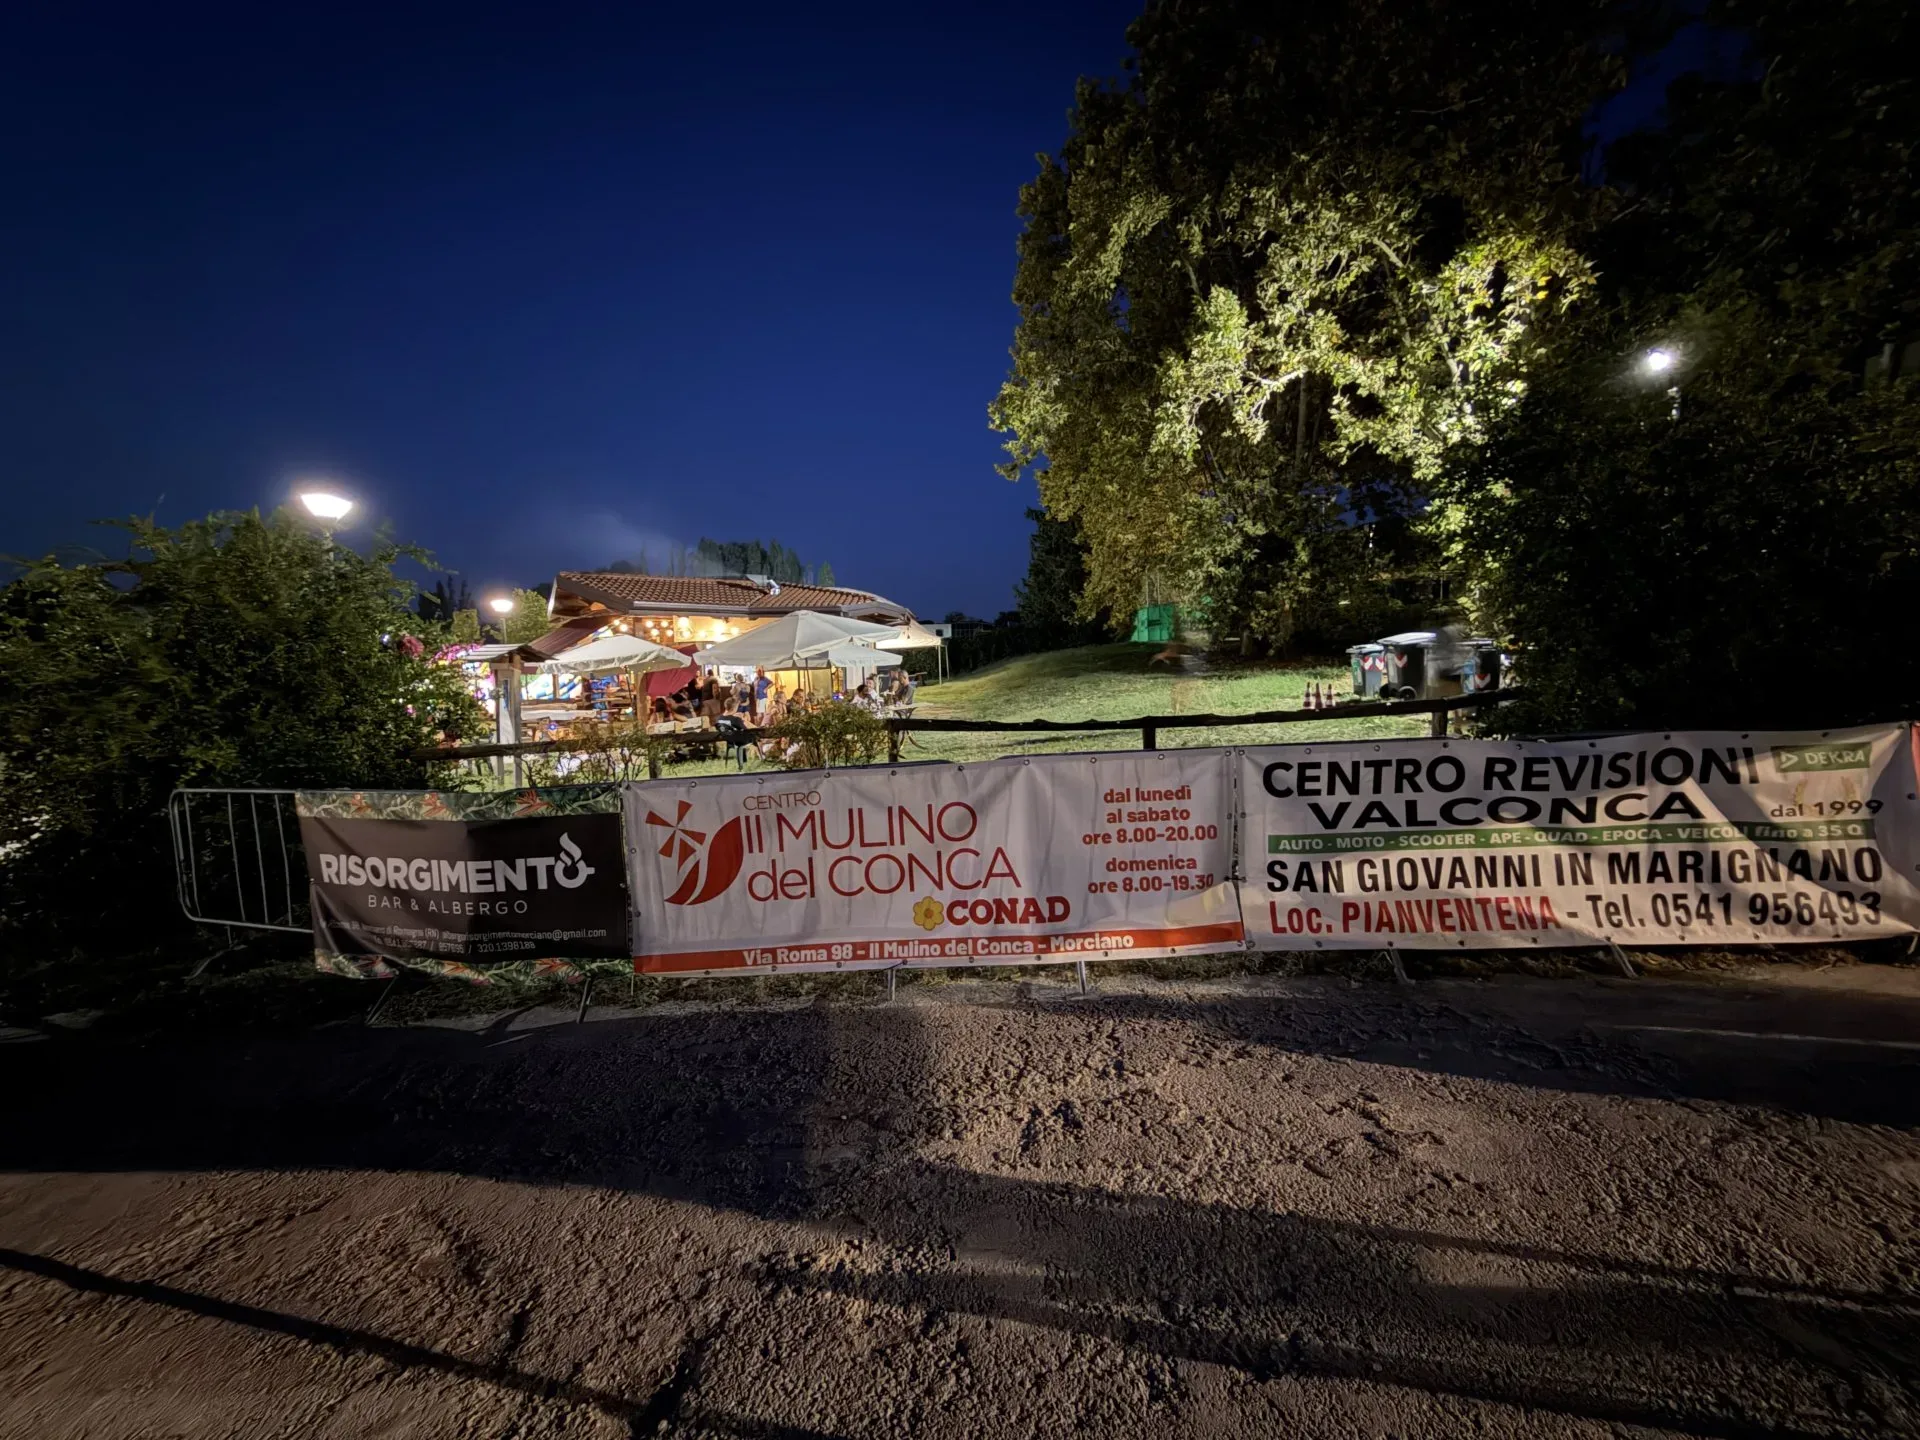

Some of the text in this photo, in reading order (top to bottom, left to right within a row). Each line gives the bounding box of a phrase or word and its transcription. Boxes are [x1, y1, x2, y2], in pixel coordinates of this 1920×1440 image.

[1805, 750, 1865, 765] DEKRA
[1262, 746, 1760, 798] CENTRO REVISIONI
[743, 790, 822, 811] CENTRO
[1103, 785, 1192, 804] dal lunedì
[1106, 807, 1190, 824] al sabato
[1307, 791, 1706, 830] VALCONCA
[1770, 800, 1884, 817] dal 1999
[776, 802, 977, 852] MULINO
[1082, 825, 1218, 845] ore 8.00-20.00
[1278, 838, 1323, 851] AUTO
[1336, 836, 1385, 849] MOTO
[1399, 833, 1476, 846] SCOOTER
[1489, 831, 1523, 845] APE
[1533, 831, 1588, 843] QUAD
[1602, 828, 1661, 841] EPOCA
[1676, 825, 1748, 839] VEICOLI
[1754, 825, 1798, 838] fino
[1802, 828, 1813, 838] a
[1818, 825, 1842, 837] 35
[1847, 824, 1864, 836] Q
[319, 849, 595, 893] RISORGIMENTO
[748, 847, 1021, 902] del CONCA
[1105, 855, 1197, 873] domenica
[1266, 846, 1883, 893] SAN GIOVANNI IN MARIGNANO
[1088, 873, 1214, 894] ore 8.00-19.30
[368, 895, 528, 915] BAR & ALBERGO
[946, 896, 1070, 926] CONAD
[1342, 895, 1563, 934] PIANVENTENA
[1585, 893, 1646, 929] Tel.
[1651, 892, 1733, 927] 0541
[1748, 891, 1882, 927] 956493
[743, 950, 772, 966] Via
[776, 948, 825, 964] Roma
[831, 944, 853, 960] 98
[869, 943, 879, 959] Il
[883, 940, 941, 958] Mulino
[944, 938, 973, 956] del
[980, 938, 1034, 954] Conca
[1050, 933, 1134, 952] Morciano
